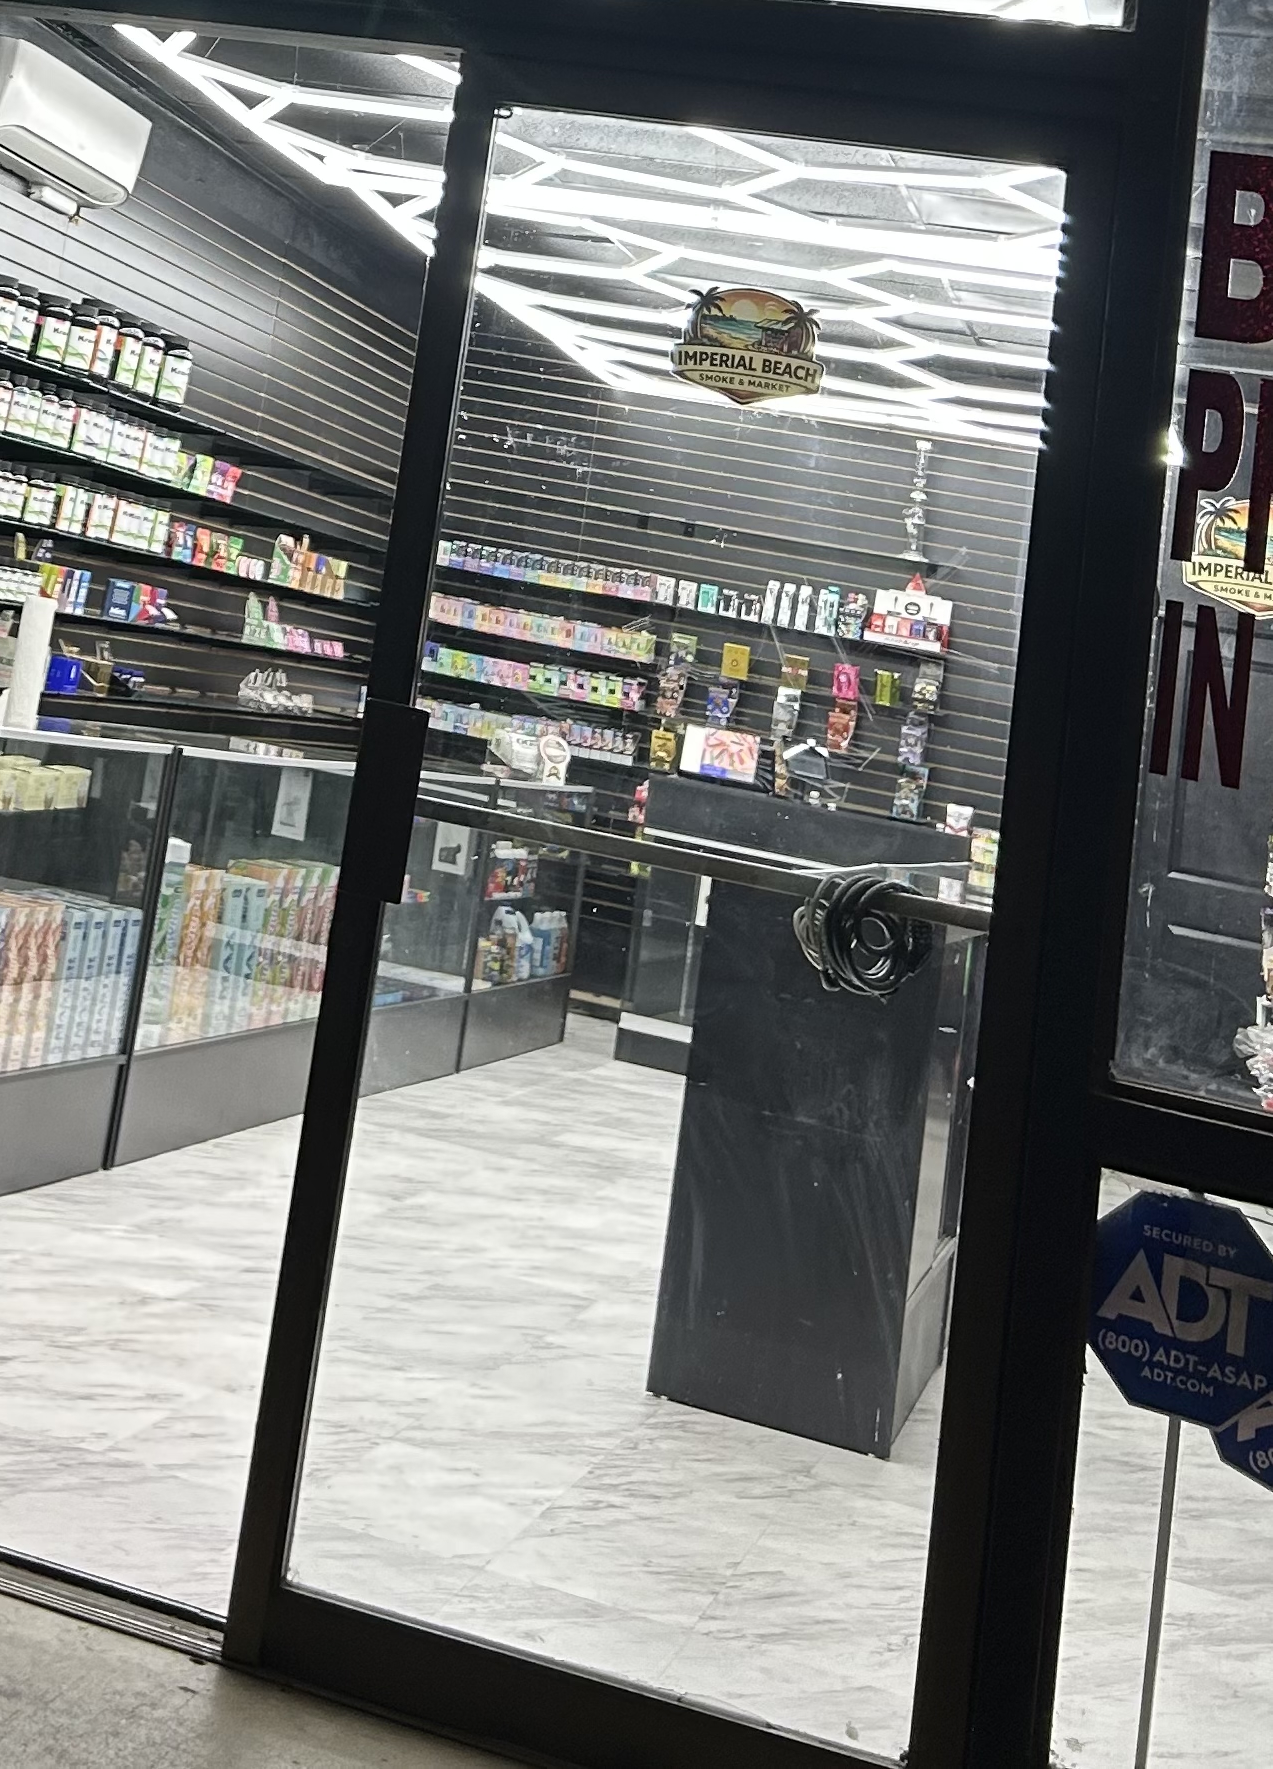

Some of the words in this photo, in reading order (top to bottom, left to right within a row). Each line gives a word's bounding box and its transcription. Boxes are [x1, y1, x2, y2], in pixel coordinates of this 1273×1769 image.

[678, 350, 757, 372] IMPERIAL
[761, 359, 818, 384] BEACH
[698, 373, 735, 385] SMOKE
[738, 376, 744, 385] &
[747, 379, 791, 393] MARKET
[1213, 584, 1251, 598] SMOKE
[1149, 597, 1255, 791] IN
[1143, 1224, 1214, 1254] SECURED
[1217, 1244, 1238, 1260] BY
[1096, 1247, 1273, 1358] ADT
[1098, 1329, 1152, 1362] (800)
[1152, 1345, 1269, 1393] ADT-ASAP
[1140, 1365, 1215, 1398] ADT.COM
